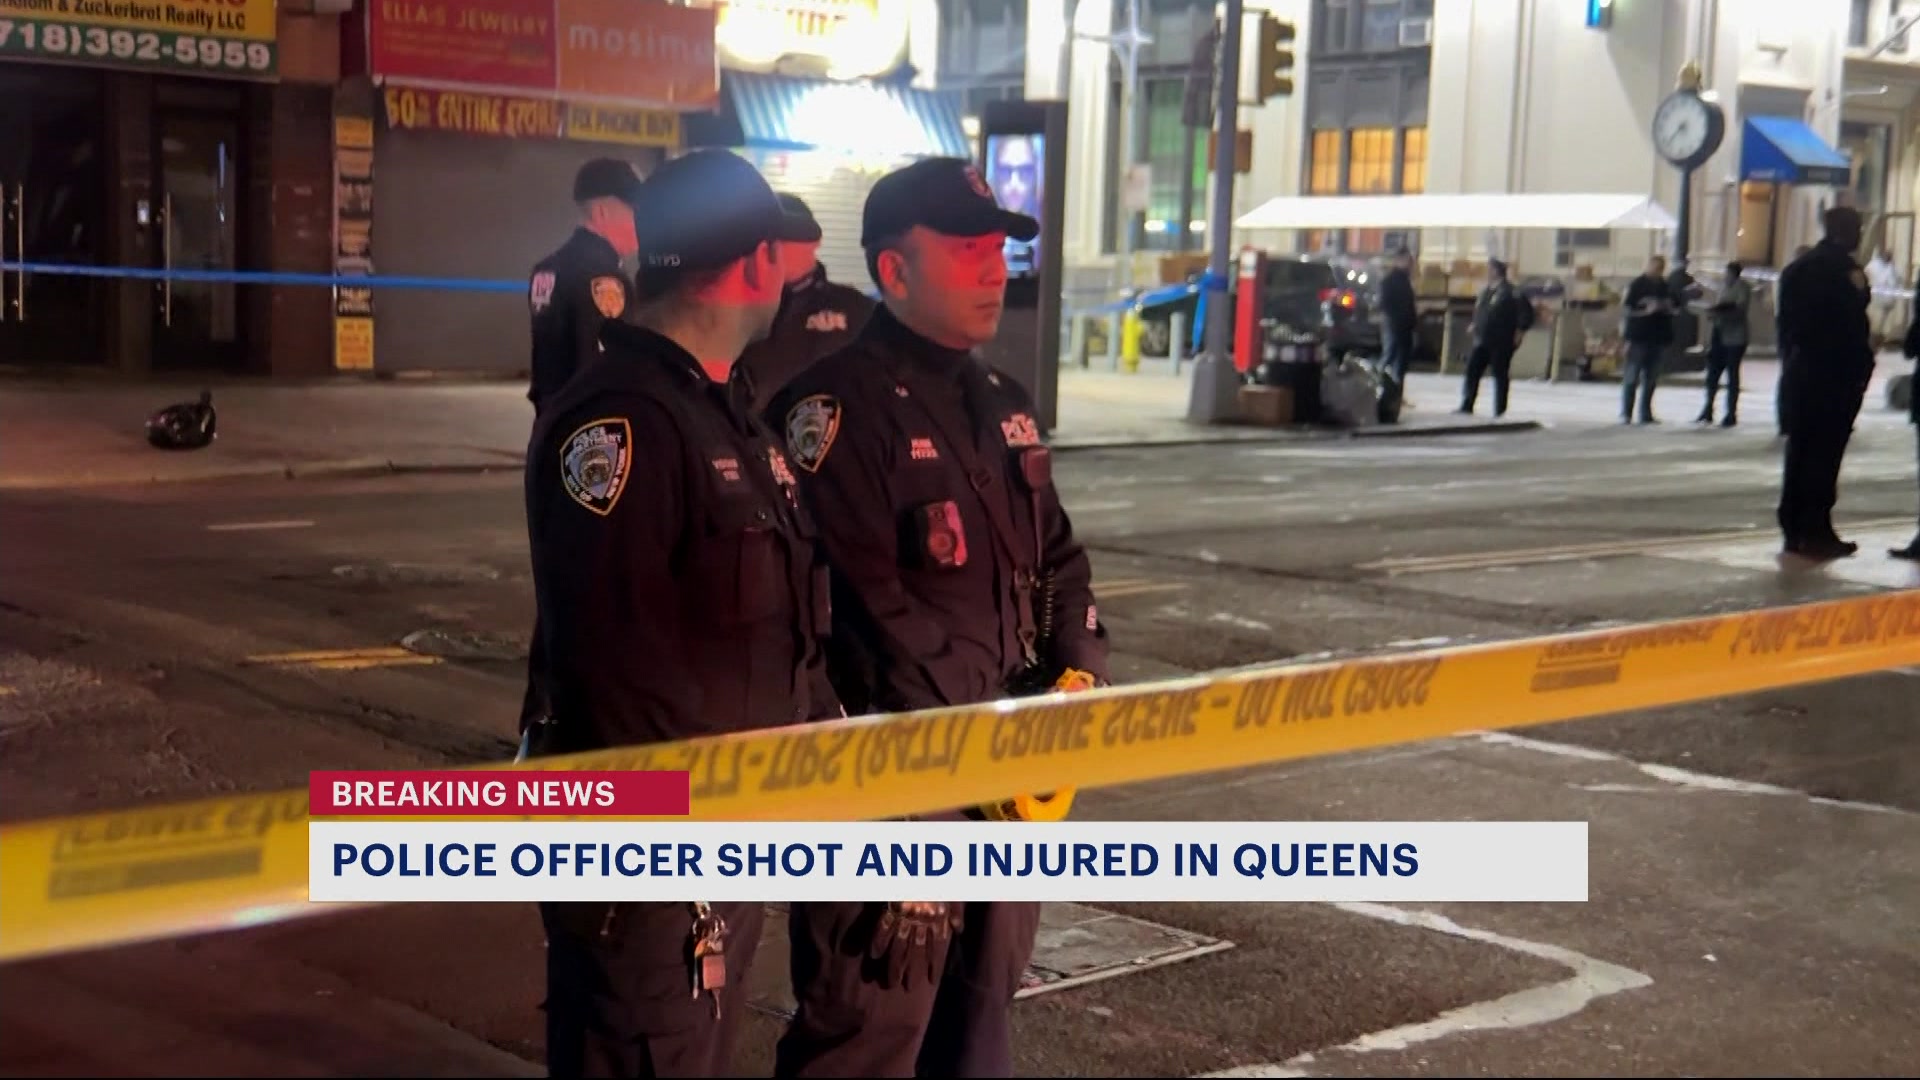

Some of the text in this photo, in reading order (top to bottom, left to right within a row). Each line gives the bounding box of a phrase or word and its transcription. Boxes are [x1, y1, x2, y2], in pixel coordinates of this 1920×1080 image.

[73, 0, 161, 21] Zuckerbrot
[166, 4, 213, 31] Realty
[218, 10, 246, 30] LLC
[455, 7, 548, 36] JEWELRY
